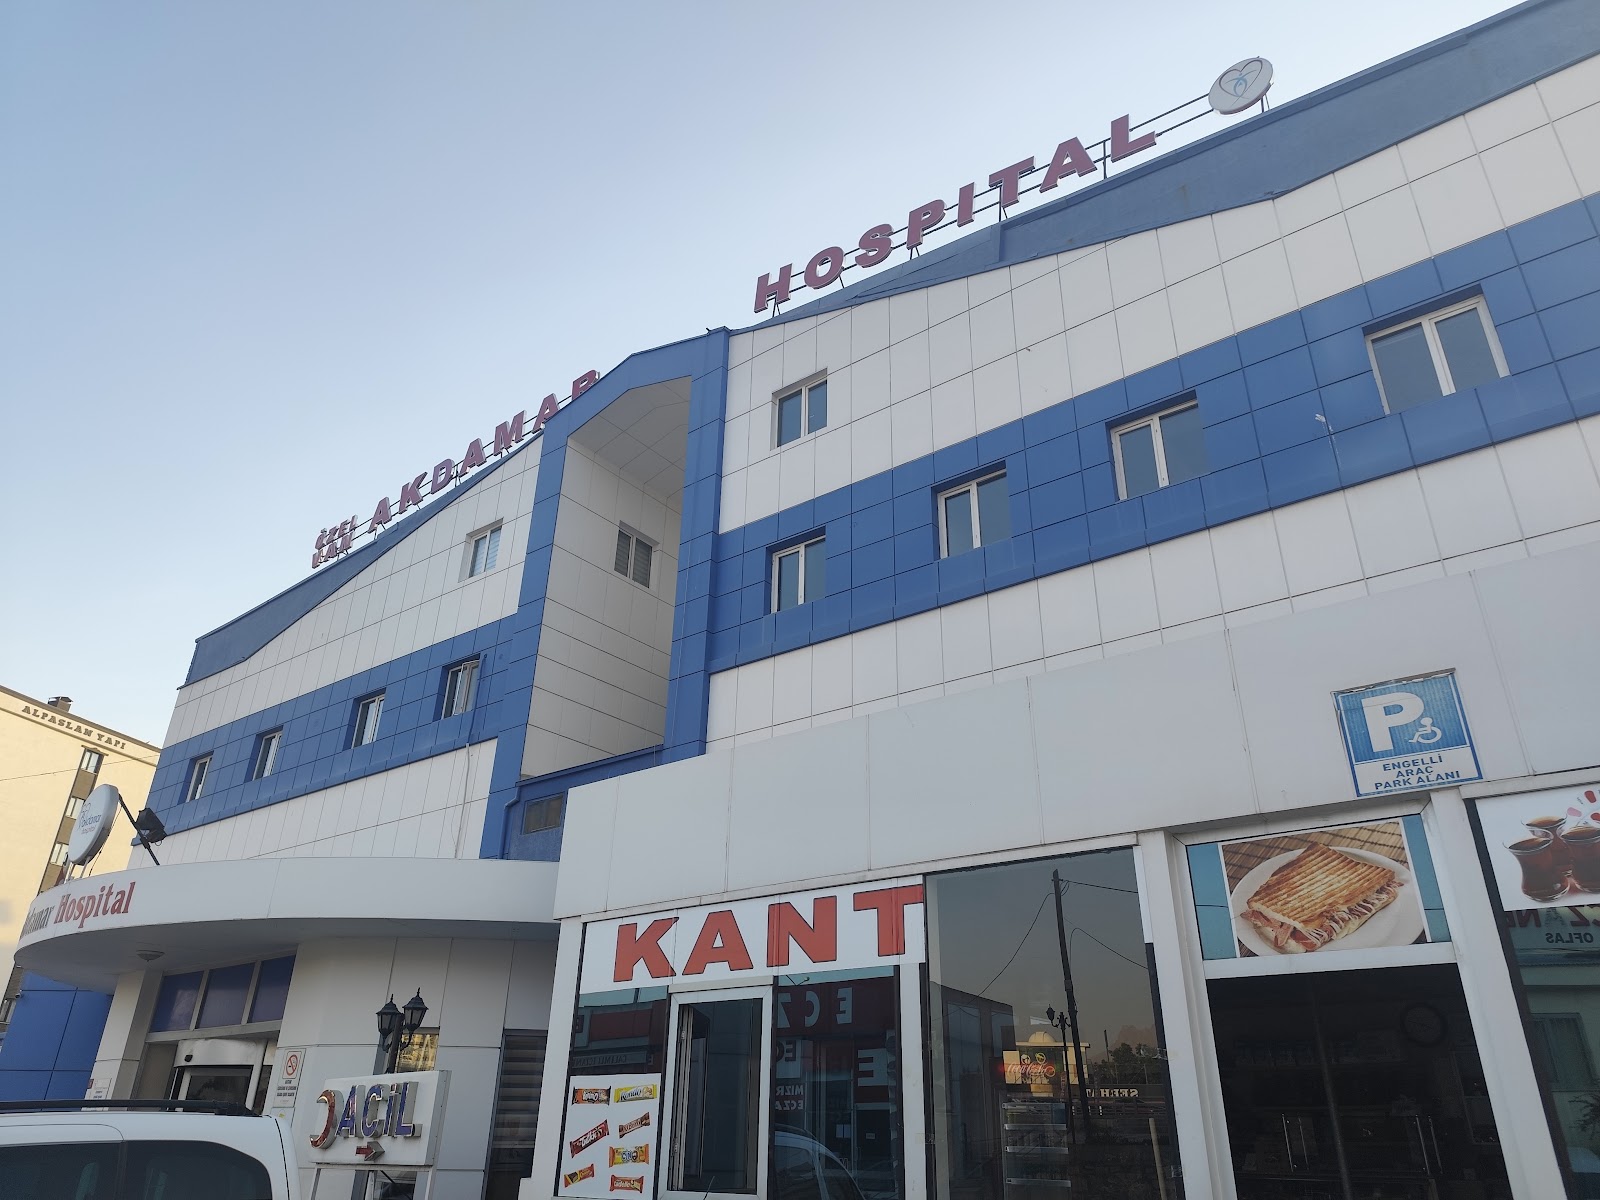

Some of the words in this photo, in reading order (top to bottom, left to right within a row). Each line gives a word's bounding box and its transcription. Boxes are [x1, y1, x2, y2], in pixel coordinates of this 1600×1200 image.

[754, 114, 1157, 313] HOSPITAL
[312, 532, 355, 569] VAN
[22, 705, 93, 737] ALPASLAN
[97, 733, 126, 749] YAPI
[1361, 691, 1425, 752] P
[1375, 779, 1412, 790] PARK
[1416, 771, 1460, 784] ALANI
[1383, 754, 1443, 771] ENGELLİ
[1396, 766, 1433, 778] ARAÇ
[53, 881, 136, 929] Hospital
[612, 884, 924, 983] KANT
